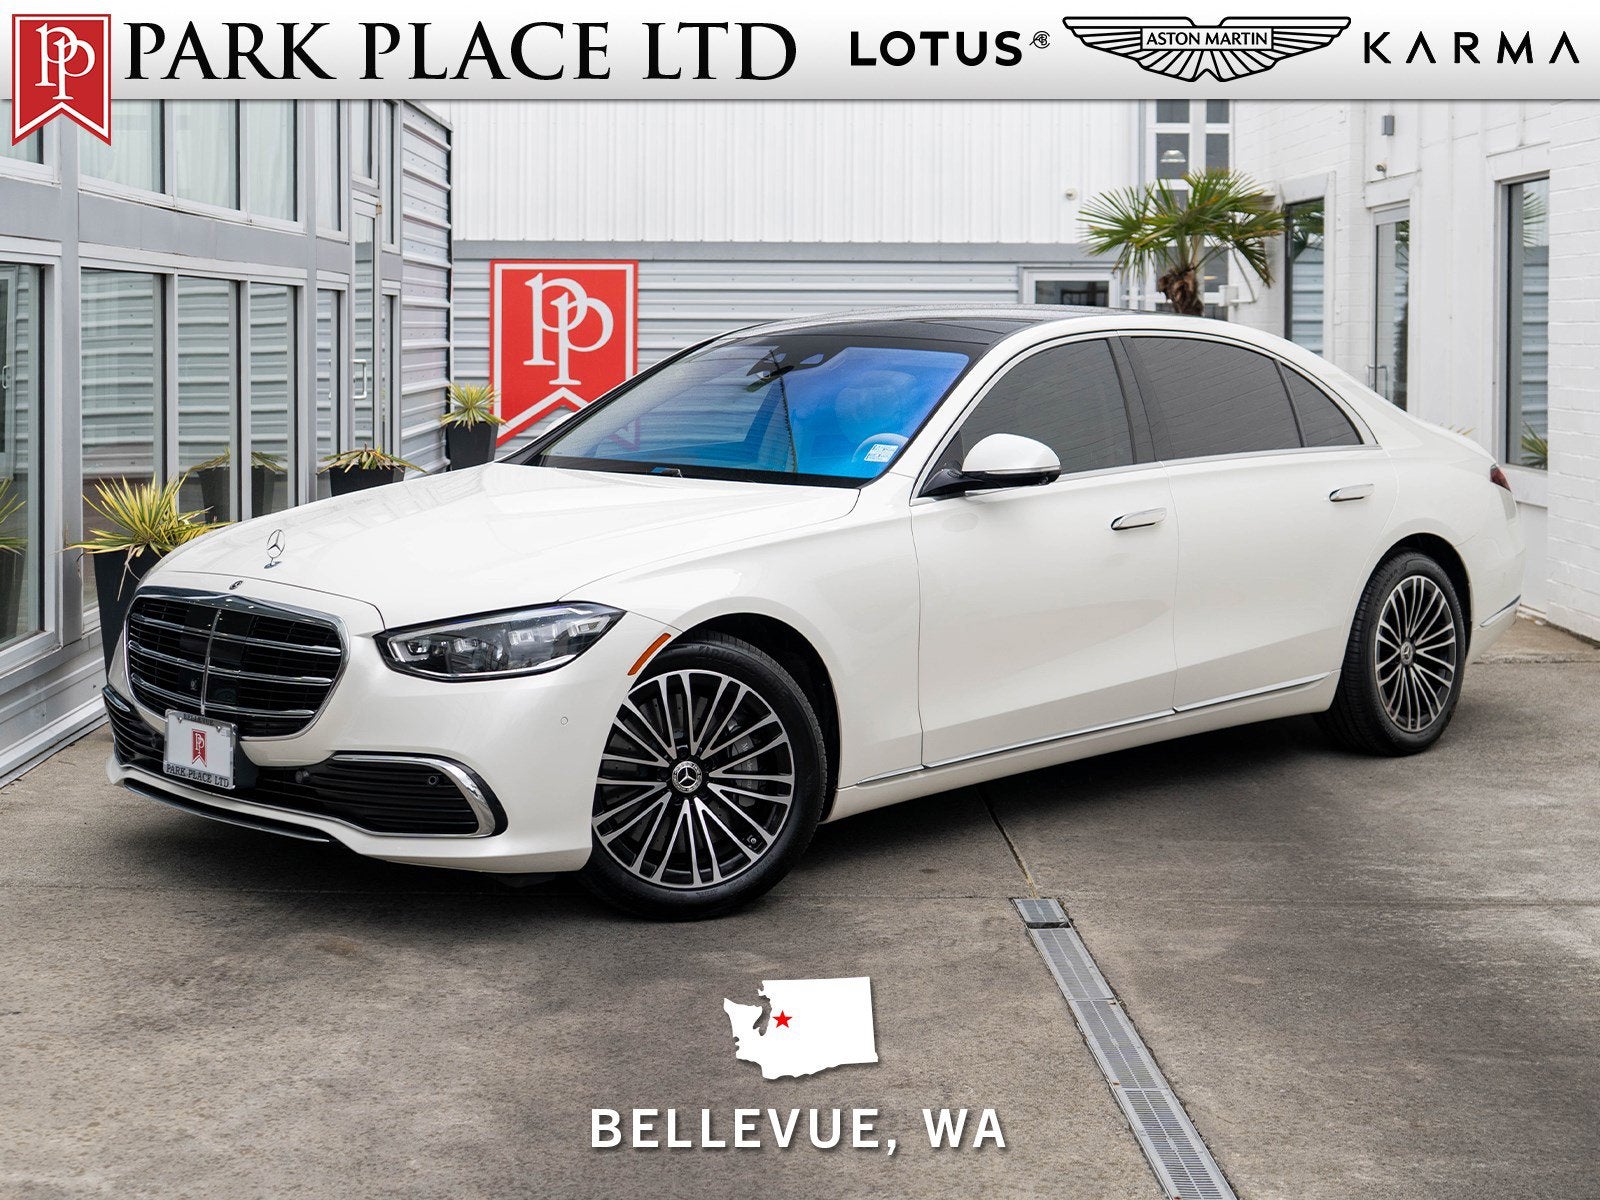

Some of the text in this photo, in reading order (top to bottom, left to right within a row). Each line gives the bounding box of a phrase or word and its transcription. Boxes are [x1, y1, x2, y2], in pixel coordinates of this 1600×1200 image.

[166, 763, 230, 788] PARK PLACE LTD
